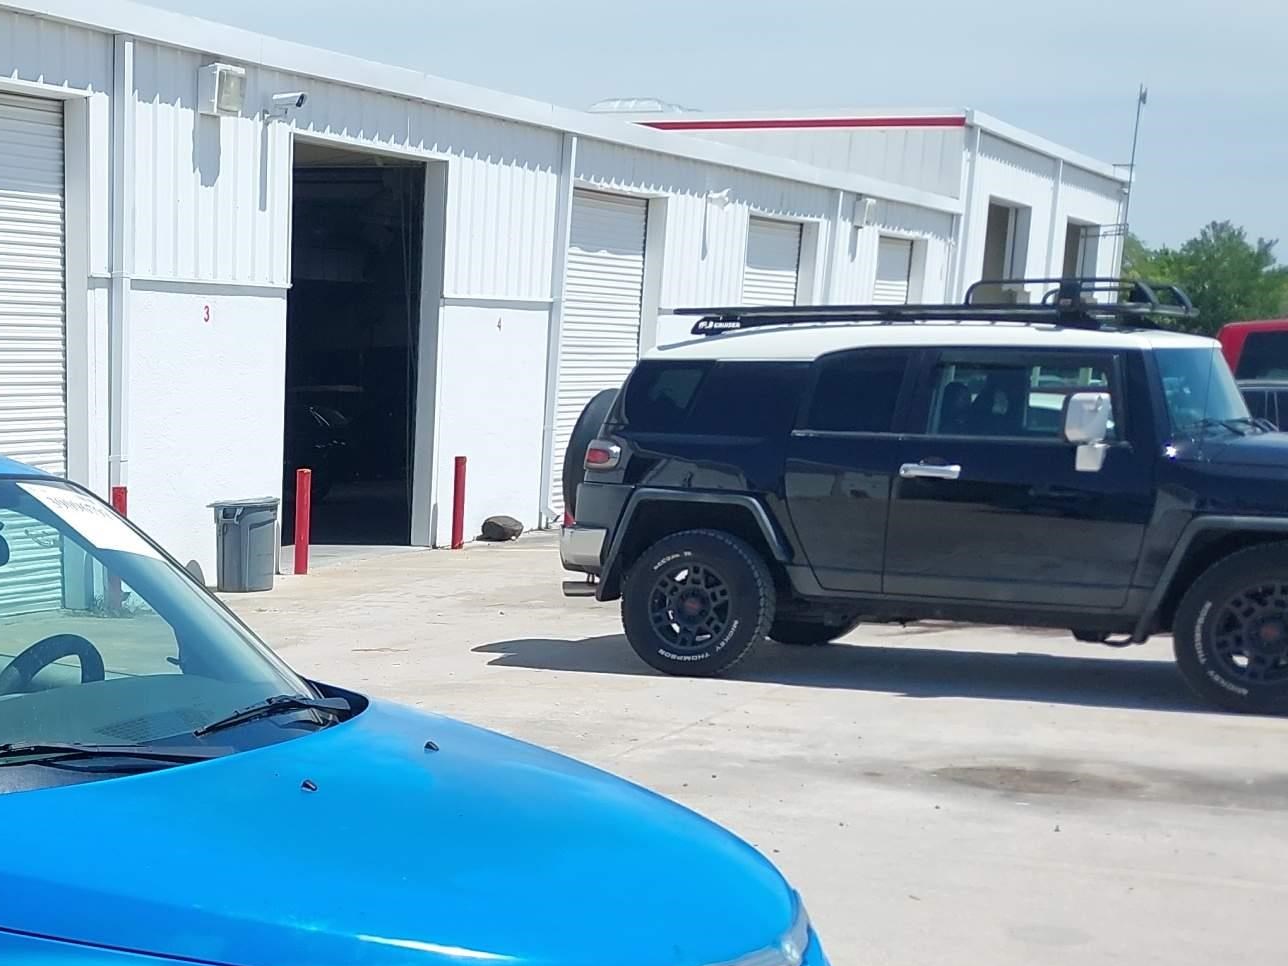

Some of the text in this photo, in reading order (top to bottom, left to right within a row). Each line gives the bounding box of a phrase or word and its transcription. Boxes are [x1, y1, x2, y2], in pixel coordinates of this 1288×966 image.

[203, 305, 210, 322] 3
[657, 620, 739, 661] MICKEY THOMPSON
